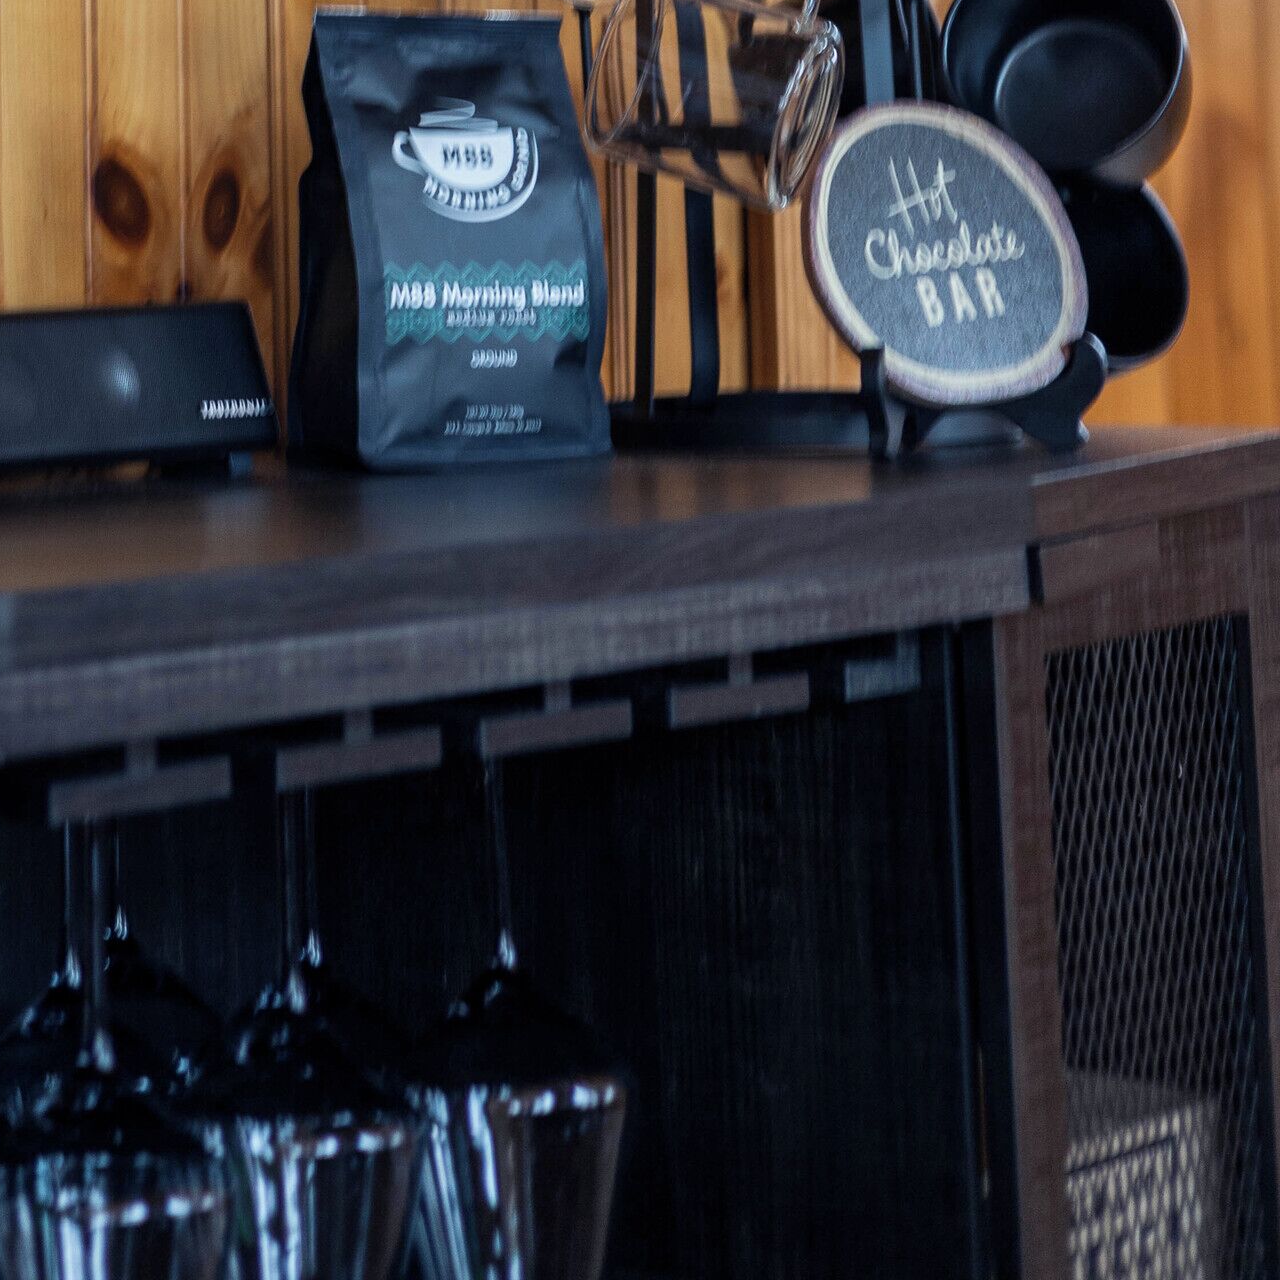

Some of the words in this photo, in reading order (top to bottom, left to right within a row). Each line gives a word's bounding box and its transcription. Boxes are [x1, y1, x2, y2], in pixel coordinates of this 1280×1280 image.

[887, 156, 958, 237] Hot
[864, 219, 1026, 280] Chocolate
[442, 279, 527, 313] Morning
[532, 278, 585, 308] Blend
[915, 267, 1006, 328] BAR
[470, 348, 518, 370] GROUND
